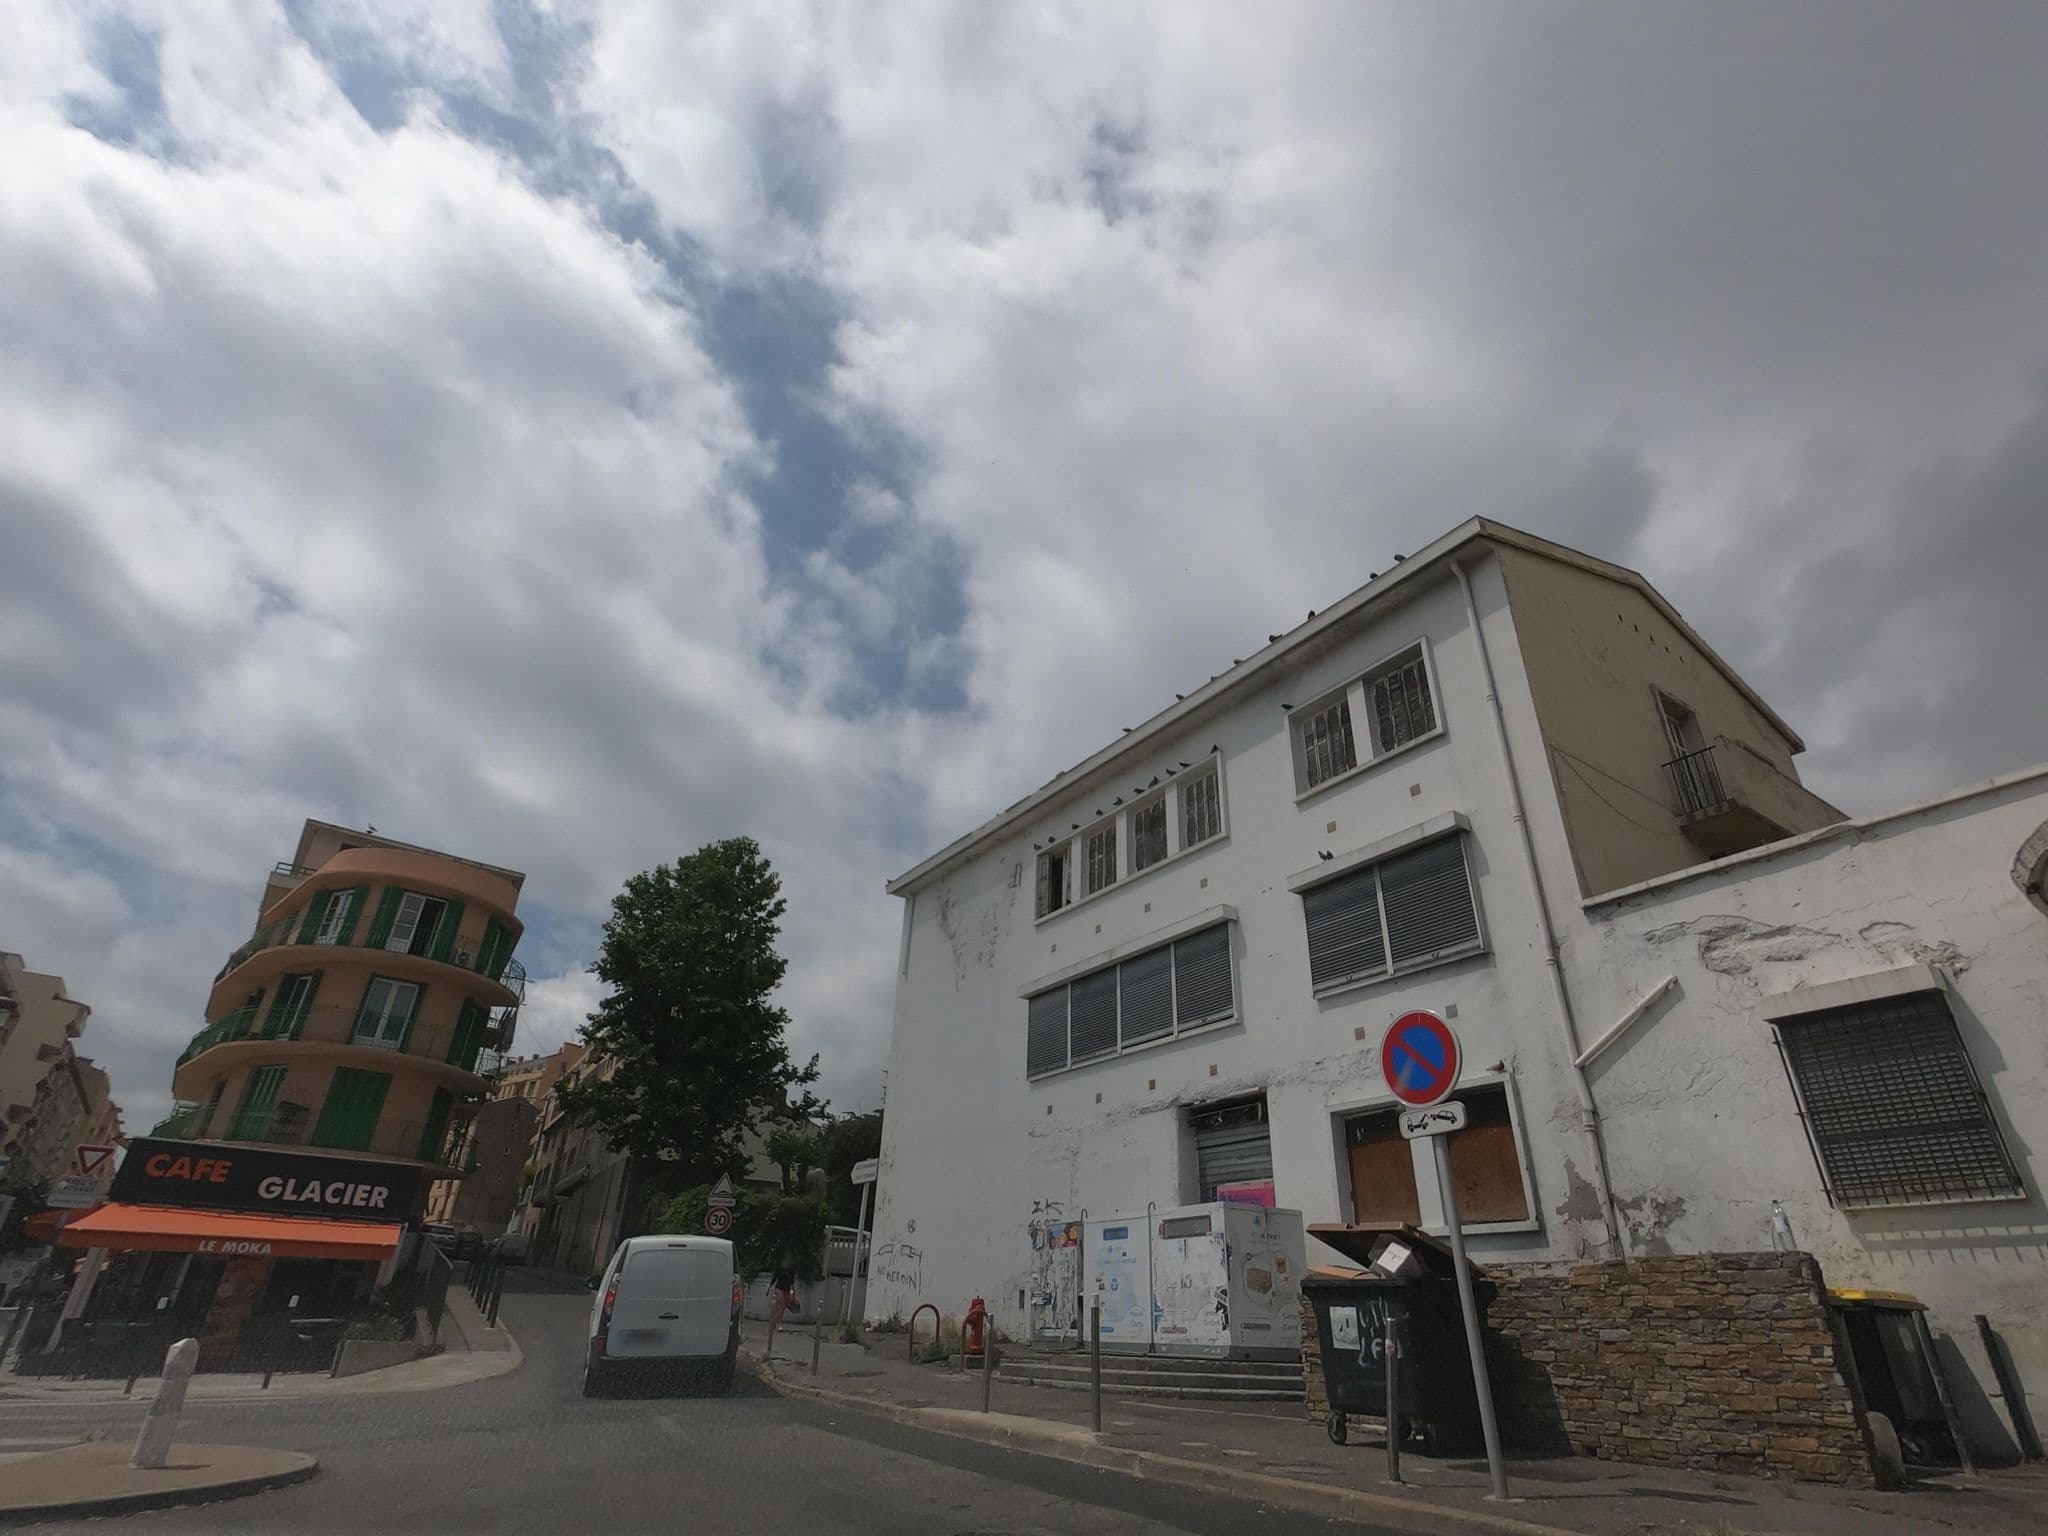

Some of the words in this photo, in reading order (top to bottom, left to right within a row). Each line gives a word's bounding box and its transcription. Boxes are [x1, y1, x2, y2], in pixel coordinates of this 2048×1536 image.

[143, 1153, 232, 1184] CAFE
[257, 1176, 389, 1209] GLACIER
[711, 1214, 727, 1226] 30
[198, 1240, 216, 1252] LE
[222, 1241, 272, 1254] MOKA
